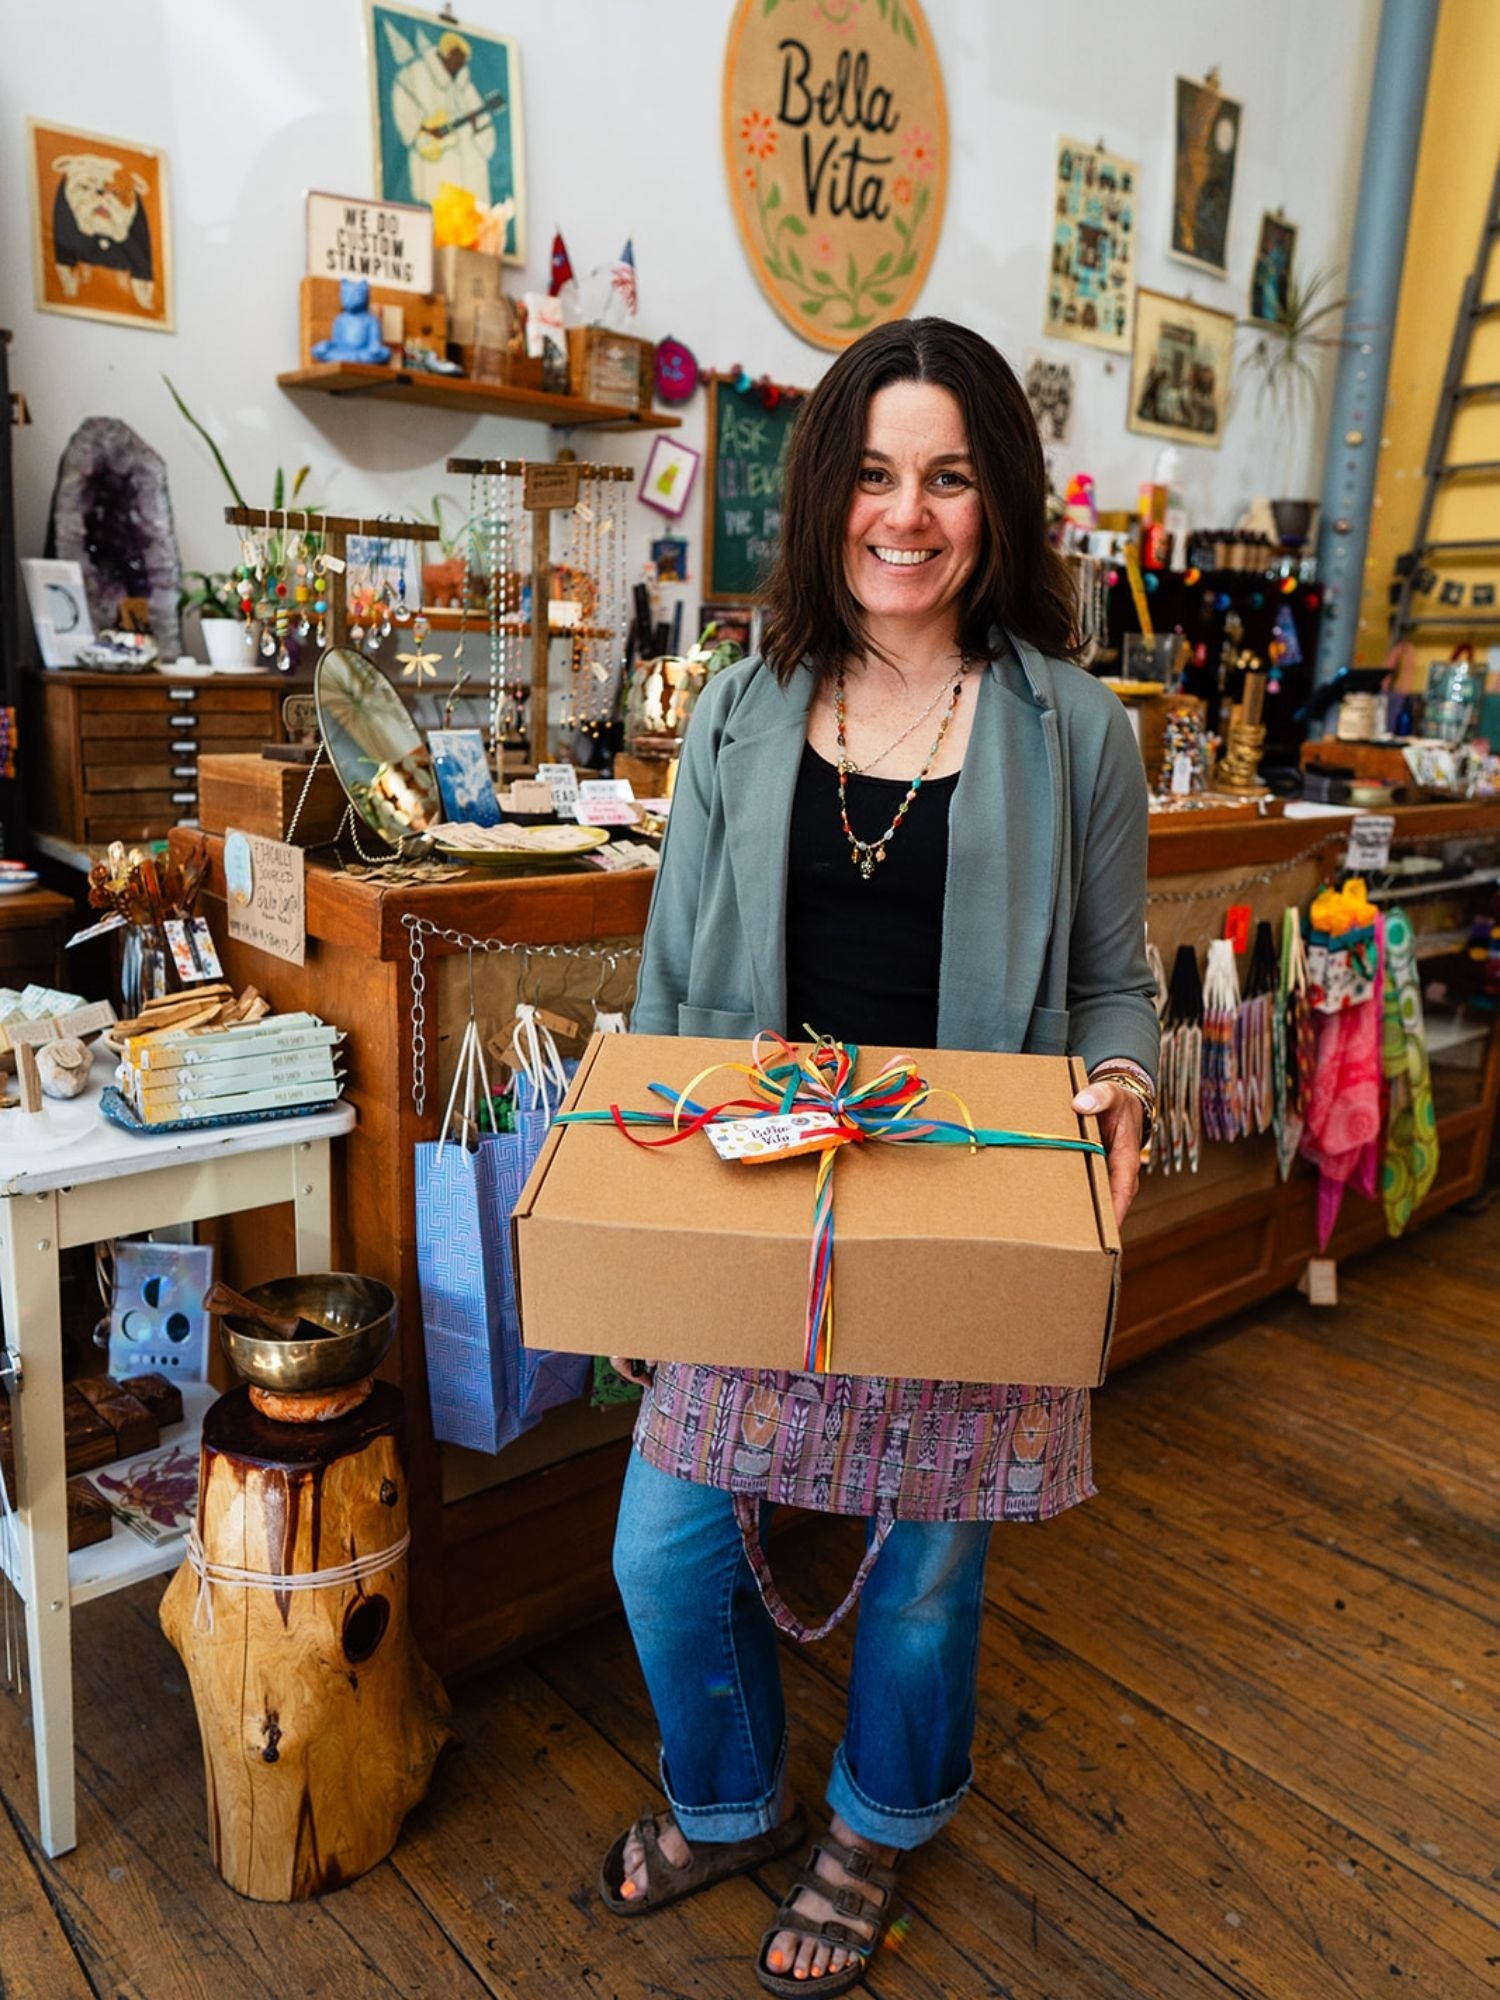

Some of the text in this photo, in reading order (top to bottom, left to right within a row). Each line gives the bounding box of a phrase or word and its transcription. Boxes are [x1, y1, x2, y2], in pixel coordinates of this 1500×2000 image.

[778, 38, 900, 134] Bella
[803, 132, 893, 221] Vita
[344, 207, 399, 235] WE DO
[336, 228, 404, 257] CUSTOM
[326, 248, 413, 282] STAMPING
[551, 789, 576, 803] EAD
